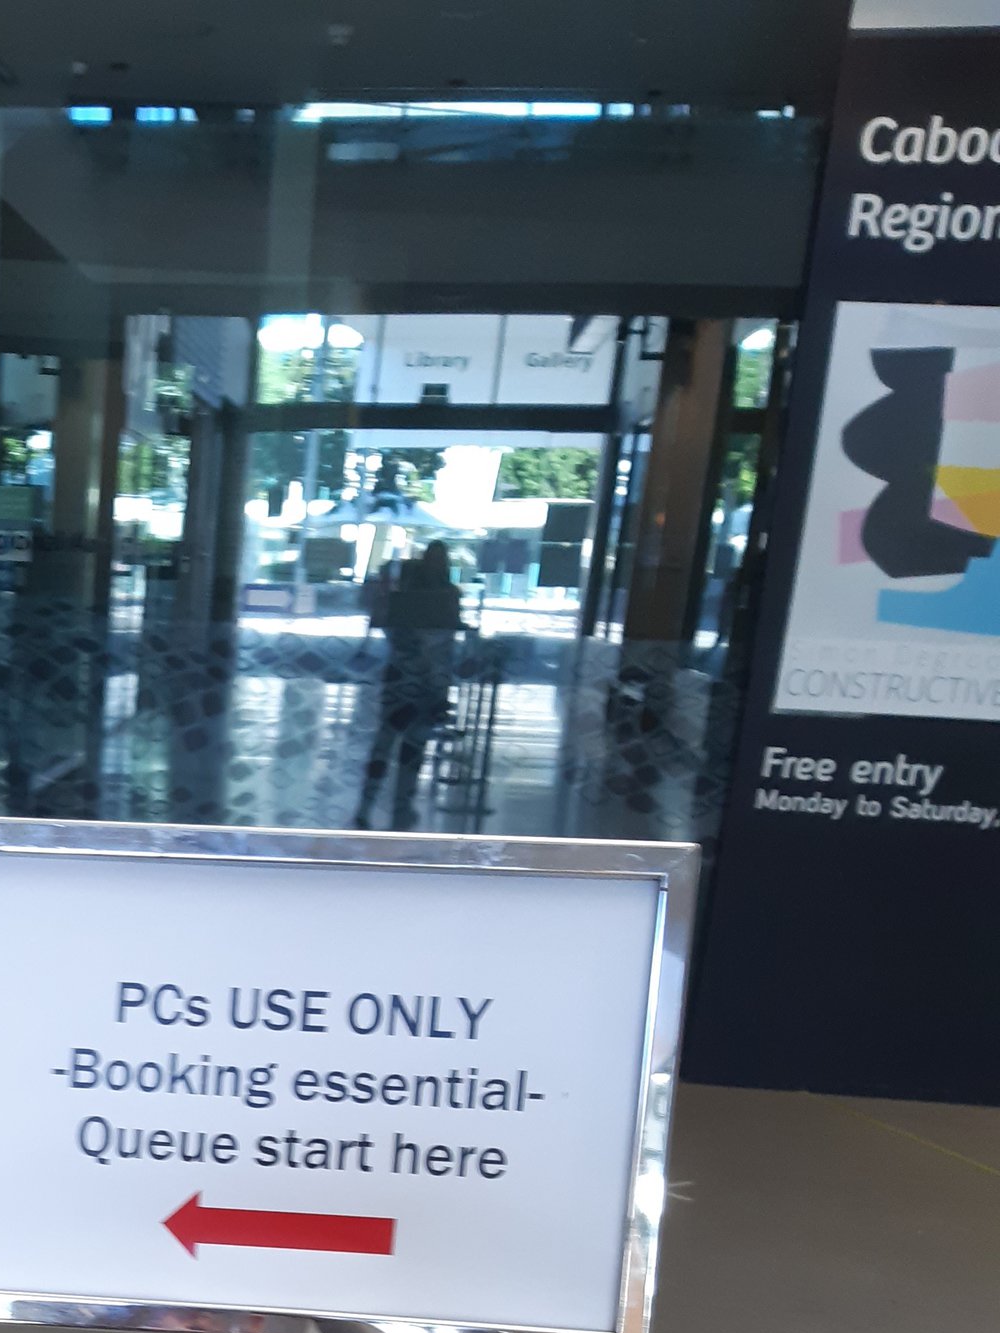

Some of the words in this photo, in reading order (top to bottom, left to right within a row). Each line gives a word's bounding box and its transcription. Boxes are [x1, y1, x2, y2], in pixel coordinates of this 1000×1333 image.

[405, 352, 470, 372] Library
[525, 352, 594, 373] Gallery
[760, 746, 836, 782] Free
[850, 753, 944, 796] entry
[753, 787, 849, 820] Monday
[856, 794, 882, 817] to
[114, 981, 211, 1028] PCs
[228, 986, 331, 1034] USE
[347, 992, 494, 1041] ONLY
[50, 1046, 278, 1109] -Booking
[292, 1067, 545, 1112] essential-
[76, 1115, 239, 1166] Queue
[252, 1128, 376, 1173] start
[392, 1132, 509, 1179] here
